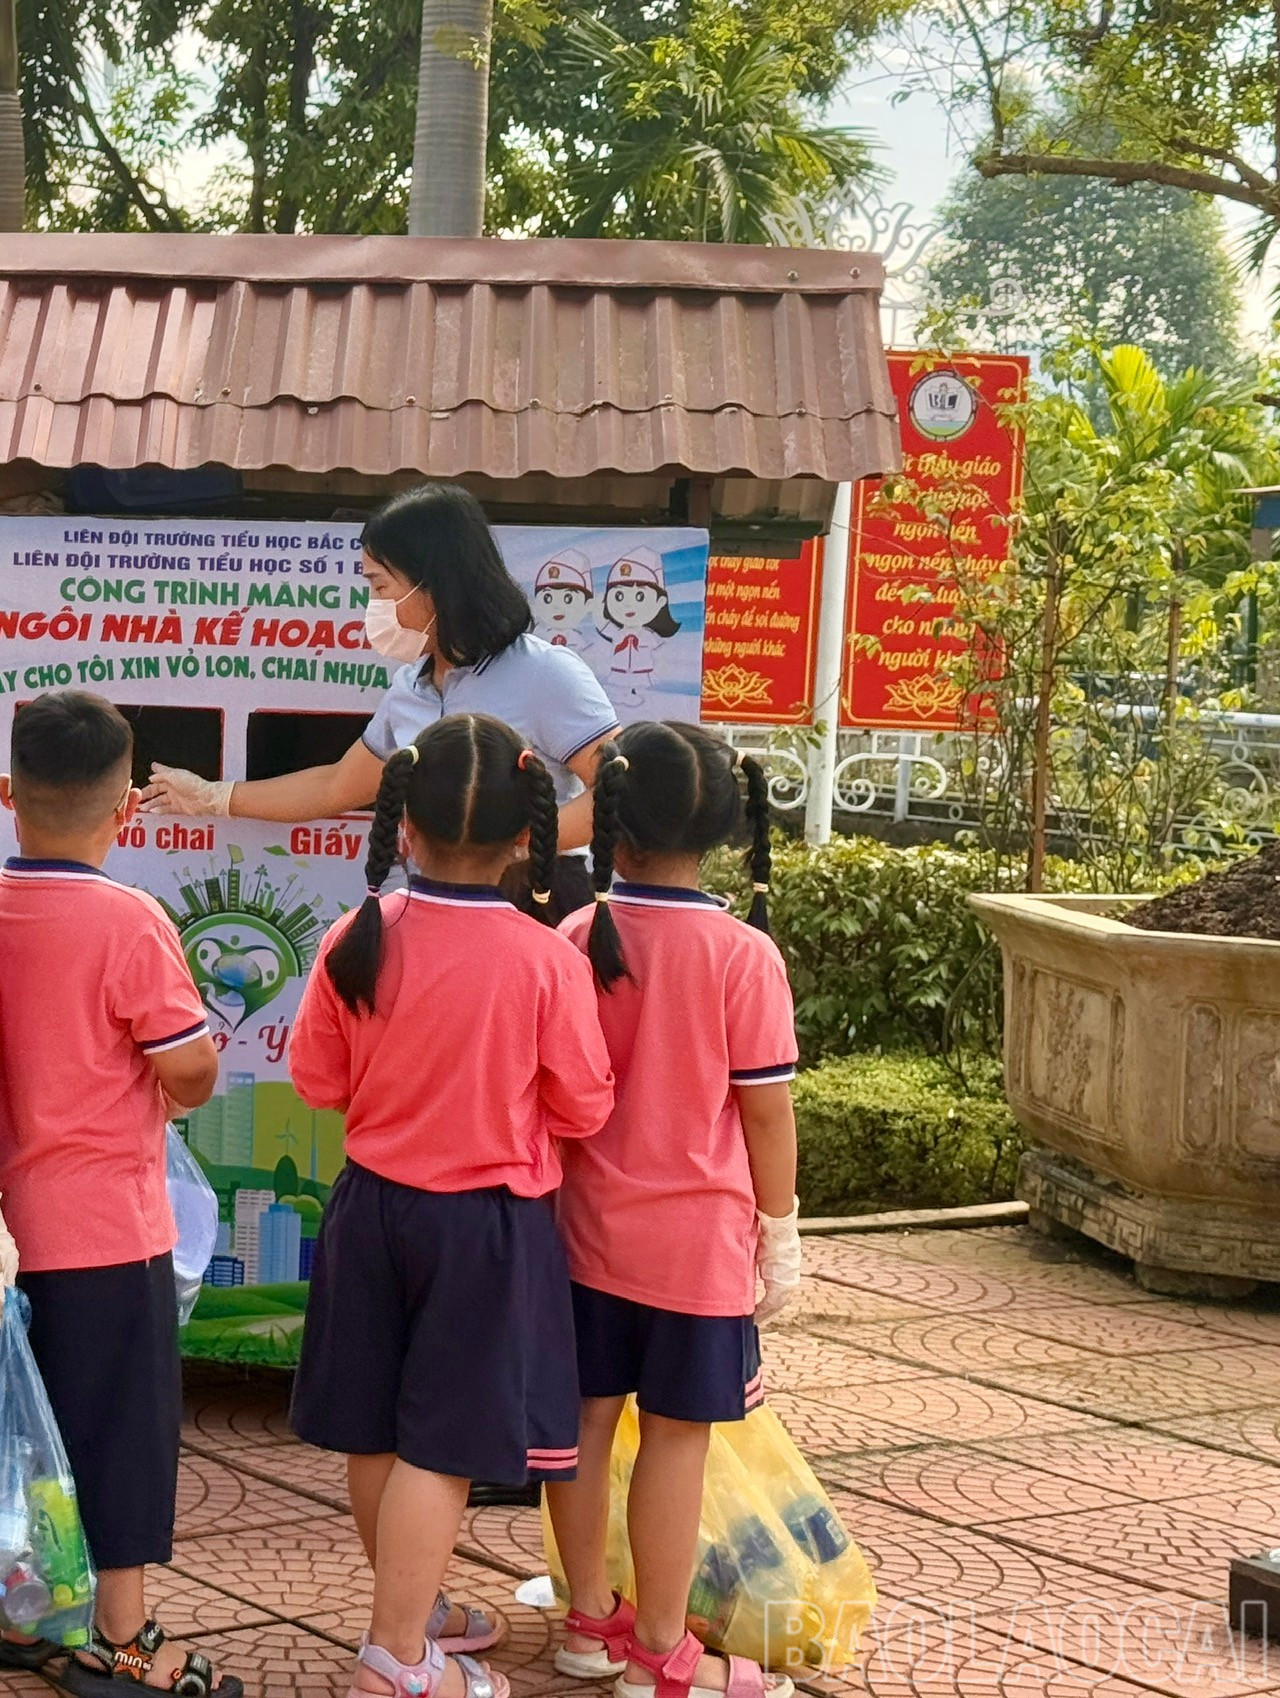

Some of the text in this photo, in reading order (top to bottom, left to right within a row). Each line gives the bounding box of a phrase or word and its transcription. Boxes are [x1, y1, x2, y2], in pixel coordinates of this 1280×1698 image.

[961, 454, 1002, 480] giáo
[63, 529, 103, 544] LIÊN
[108, 530, 139, 547] ĐỘI
[144, 531, 216, 547] TRƯỜNG
[221, 530, 260, 548] TIỂU
[265, 535, 302, 551] HỌC
[307, 532, 344, 550] BẮC
[13, 549, 59, 566] LIÊN
[65, 551, 101, 570] ĐỘI
[107, 552, 191, 571] TRƯỜNG
[197, 551, 243, 572] TIỂU
[249, 557, 292, 575] HỌC
[298, 555, 328, 574] SỐ
[334, 560, 344, 574] 1
[59, 575, 146, 603] CÔNG
[153, 577, 239, 606] TRÌNH
[246, 580, 341, 609] MĂNG
[736, 584, 761, 602] ngọn
[761, 579, 781, 600] nến
[100, 608, 183, 645] NHÀ
[193, 606, 251, 646] KẾ
[716, 608, 741, 630] cháy
[23, 662, 73, 689] CHO
[76, 654, 115, 683] TÔI
[119, 656, 160, 680] XIN
[165, 648, 200, 678] VỎ
[205, 655, 256, 680] LON,
[261, 656, 318, 681] CHAI
[878, 647, 932, 671] người
[155, 822, 215, 850] chai
[290, 823, 362, 860] Giấy
